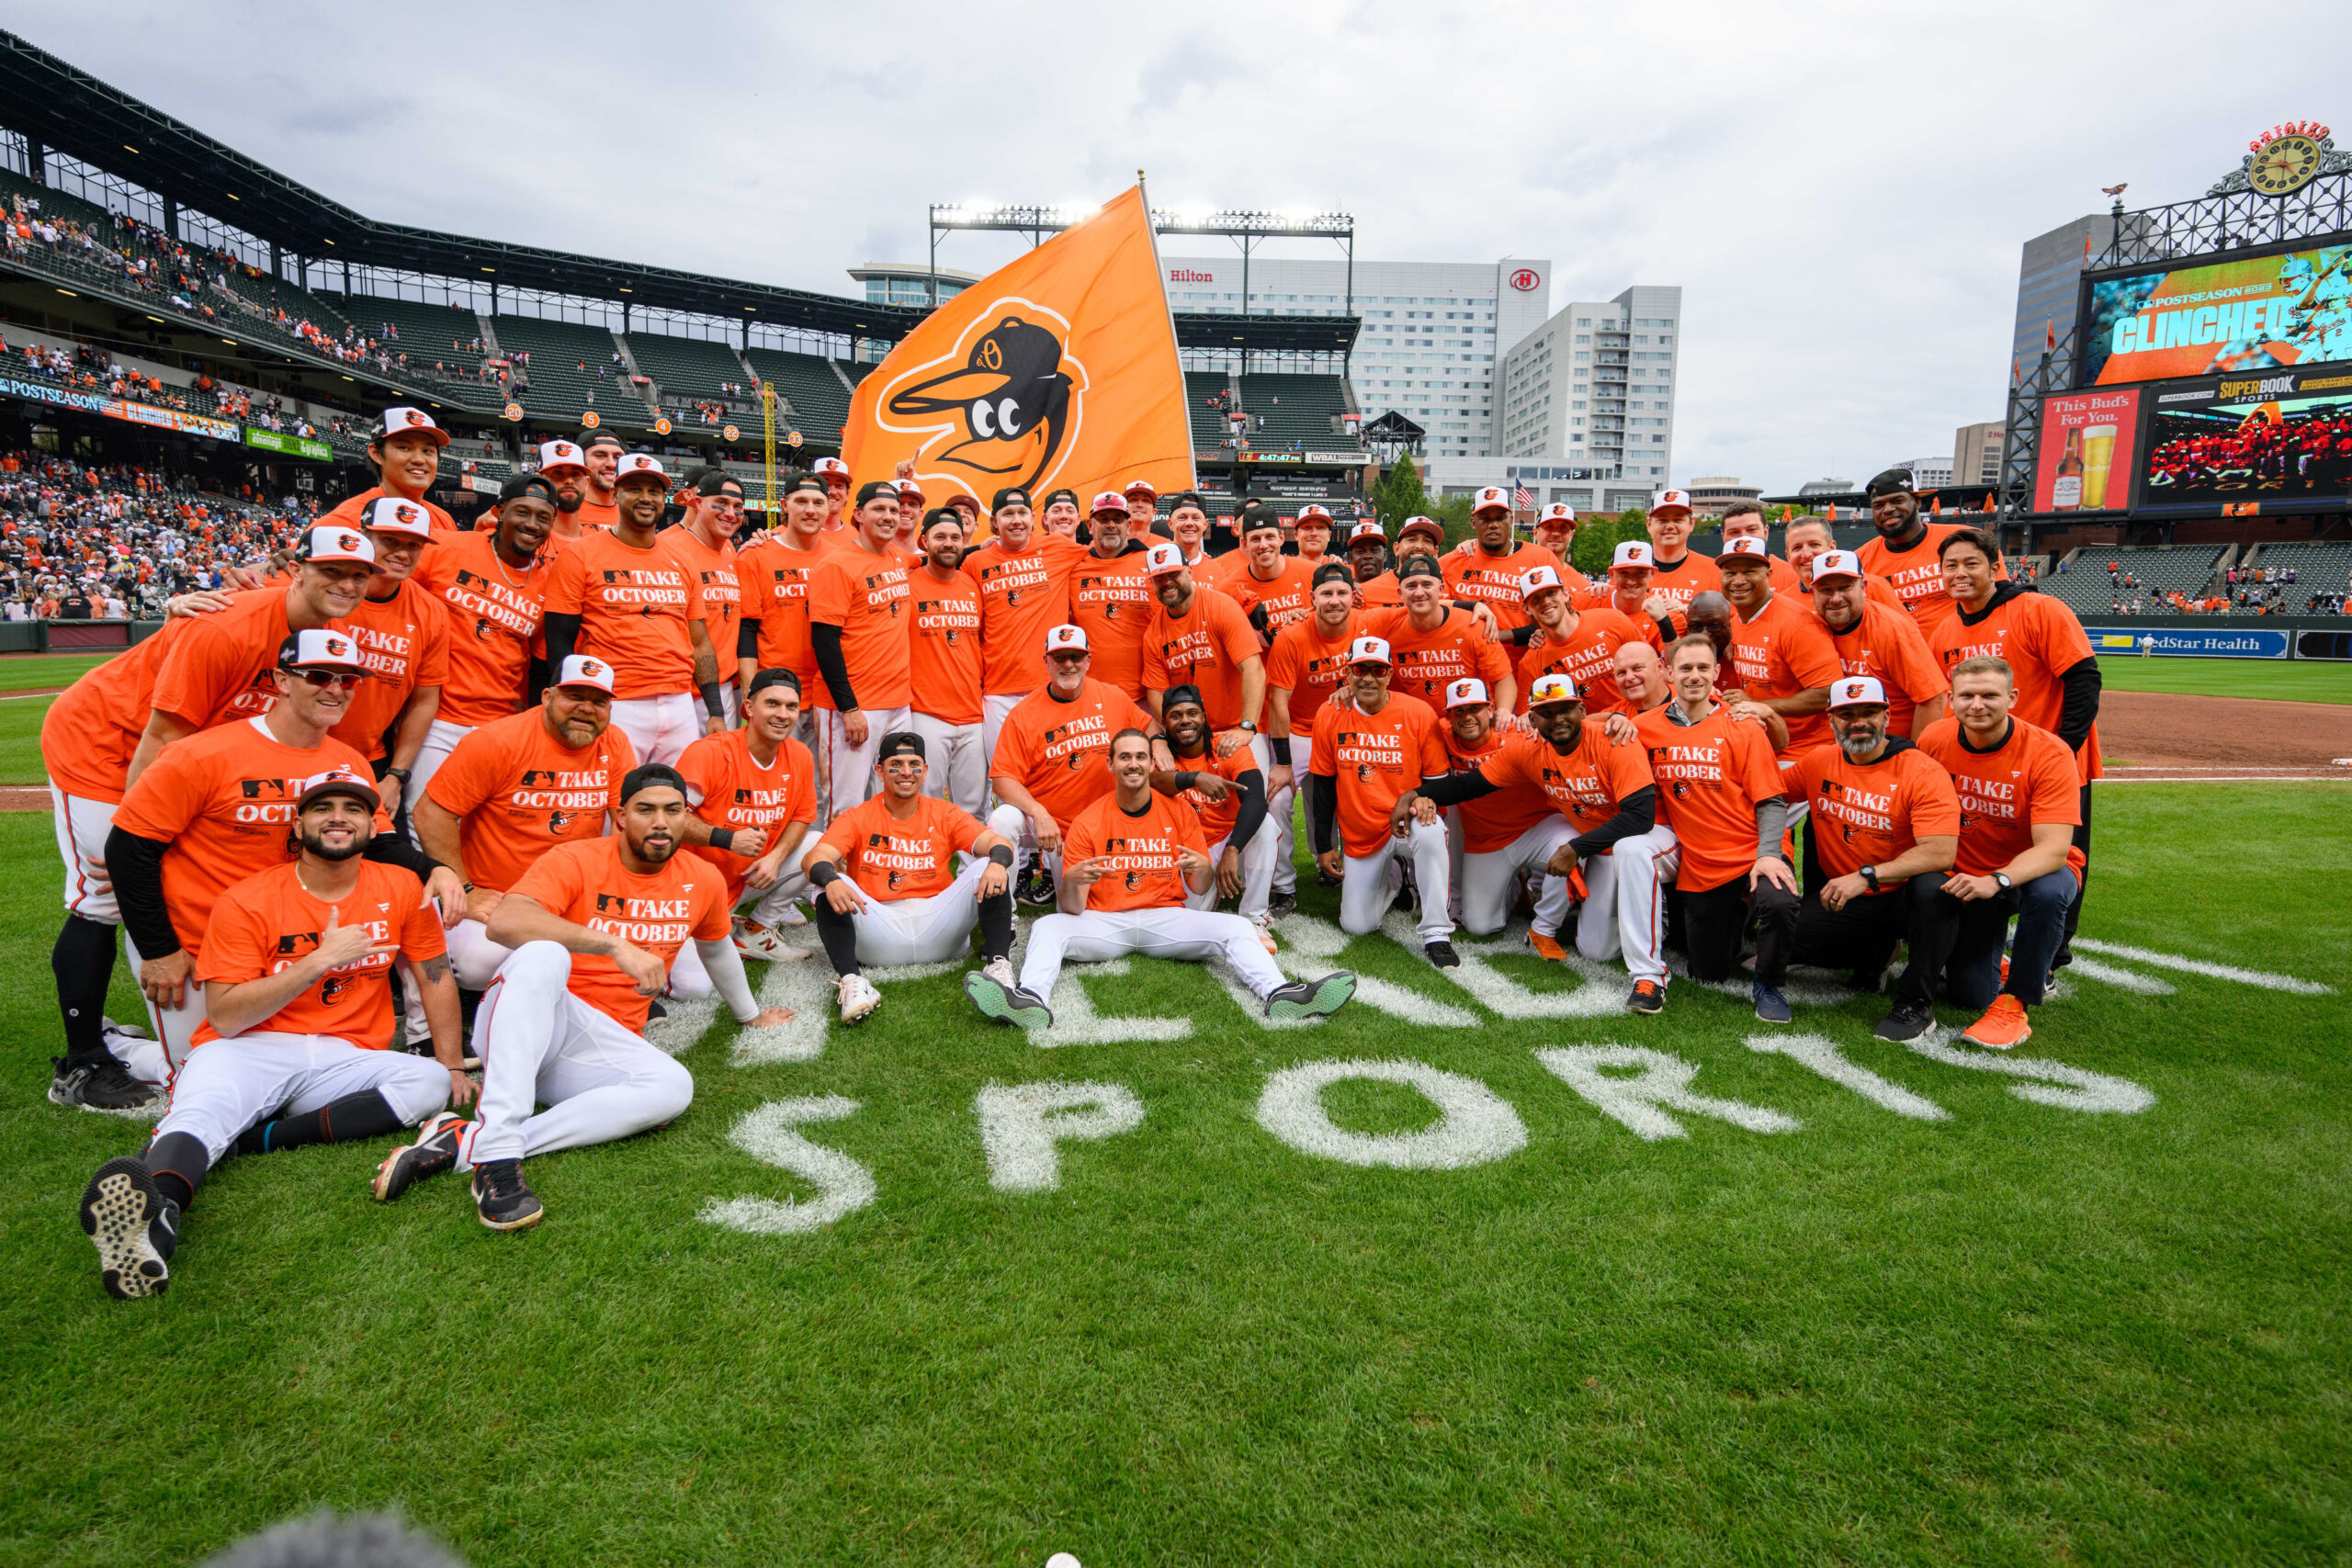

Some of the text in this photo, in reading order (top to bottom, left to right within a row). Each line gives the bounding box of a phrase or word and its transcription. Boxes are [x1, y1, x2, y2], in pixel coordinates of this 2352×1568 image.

[1170, 270, 1213, 282] Hilton
[2155, 286, 2243, 308] POSTSEASON
[2111, 296, 2297, 355] CLINCHED
[2219, 375, 2295, 399] SUPERBOOK
[12, 380, 98, 411] POSTSEASON
[127, 404, 173, 427] CLINCHED
[2161, 391, 2213, 401] SUPERBOOK.COM
[2234, 393, 2276, 403] SPORTS
[508, 408, 521, 418] 20
[2053, 400, 2086, 412] This
[588, 414, 594, 424] 5
[2060, 412, 2119, 425] For You.
[660, 423, 666, 431] 4
[726, 429, 737, 437] 22
[790, 435, 801, 444] 33
[1002, 558, 1044, 573] TAKE
[631, 570, 682, 586] TAKE
[882, 568, 908, 583] TAKE
[982, 571, 1047, 594] OCTOBER
[1103, 577, 1147, 588] TAKE
[1483, 570, 1520, 588] TAKE
[491, 581, 541, 620] TAKE
[603, 588, 686, 604] OCTOBER
[1079, 590, 1149, 602] OCTOBER
[1455, 582, 1520, 603] OCTOBER
[941, 600, 977, 613] TAKE
[1262, 593, 1302, 612] TAKE
[446, 587, 536, 637] OCTOBER
[919, 615, 979, 628] OCTOBER
[348, 625, 410, 655] TAKE
[1178, 631, 1208, 649] TAKE
[2205, 637, 2259, 650] Health
[1419, 649, 1462, 662] TAKE
[1562, 642, 1609, 669] TAKE
[1737, 645, 1766, 661] TAKE
[1962, 643, 2003, 660] TAKE
[1398, 665, 1466, 678] OCTOBER
[1068, 715, 1106, 735] TAKE
[1046, 732, 1110, 759] OCTOBER
[1357, 733, 1400, 748] TAKE
[1338, 749, 1403, 763] OCTOBER
[1669, 746, 1719, 762] TAKE
[558, 770, 608, 788] TAKE
[1959, 775, 2015, 799] TAKE
[512, 790, 608, 807] OCTOBER
[1845, 786, 1891, 812] TAKE
[1817, 797, 1893, 830] OCTOBER
[889, 836, 932, 853] TAKE
[1126, 838, 1170, 852] TAKE
[864, 851, 935, 869] OCTOBER
[1102, 856, 1172, 869] OCTOBER
[627, 898, 689, 919] TAKE
[588, 917, 689, 942] OCTOBER
[695, 1024, 2155, 1235] SPORTS
